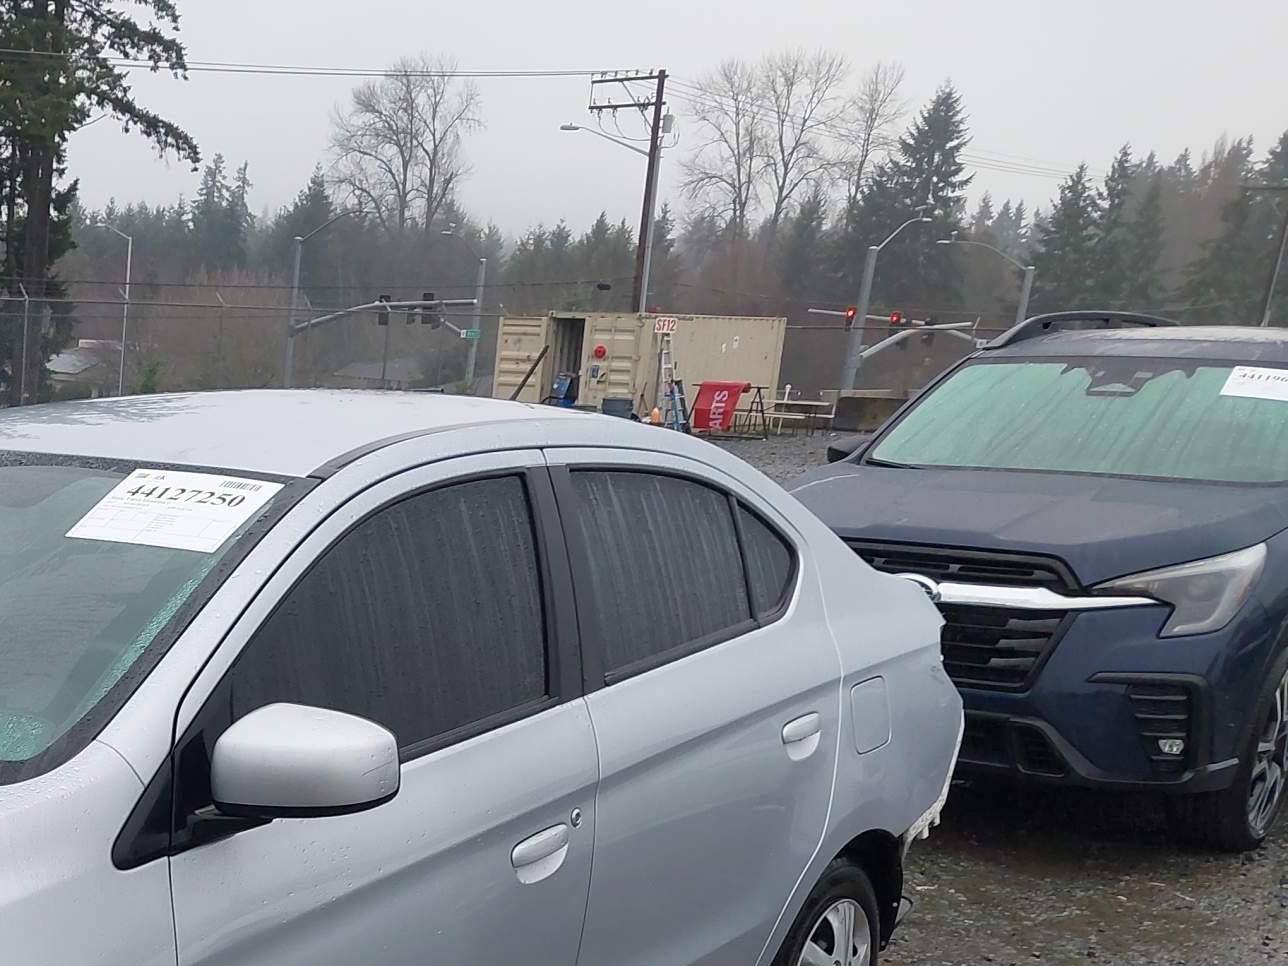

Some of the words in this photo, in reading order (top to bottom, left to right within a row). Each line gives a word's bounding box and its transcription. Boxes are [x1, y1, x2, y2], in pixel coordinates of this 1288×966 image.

[656, 318, 677, 332] SF12
[709, 390, 729, 432] ARTS
[126, 484, 246, 508] 44127250
